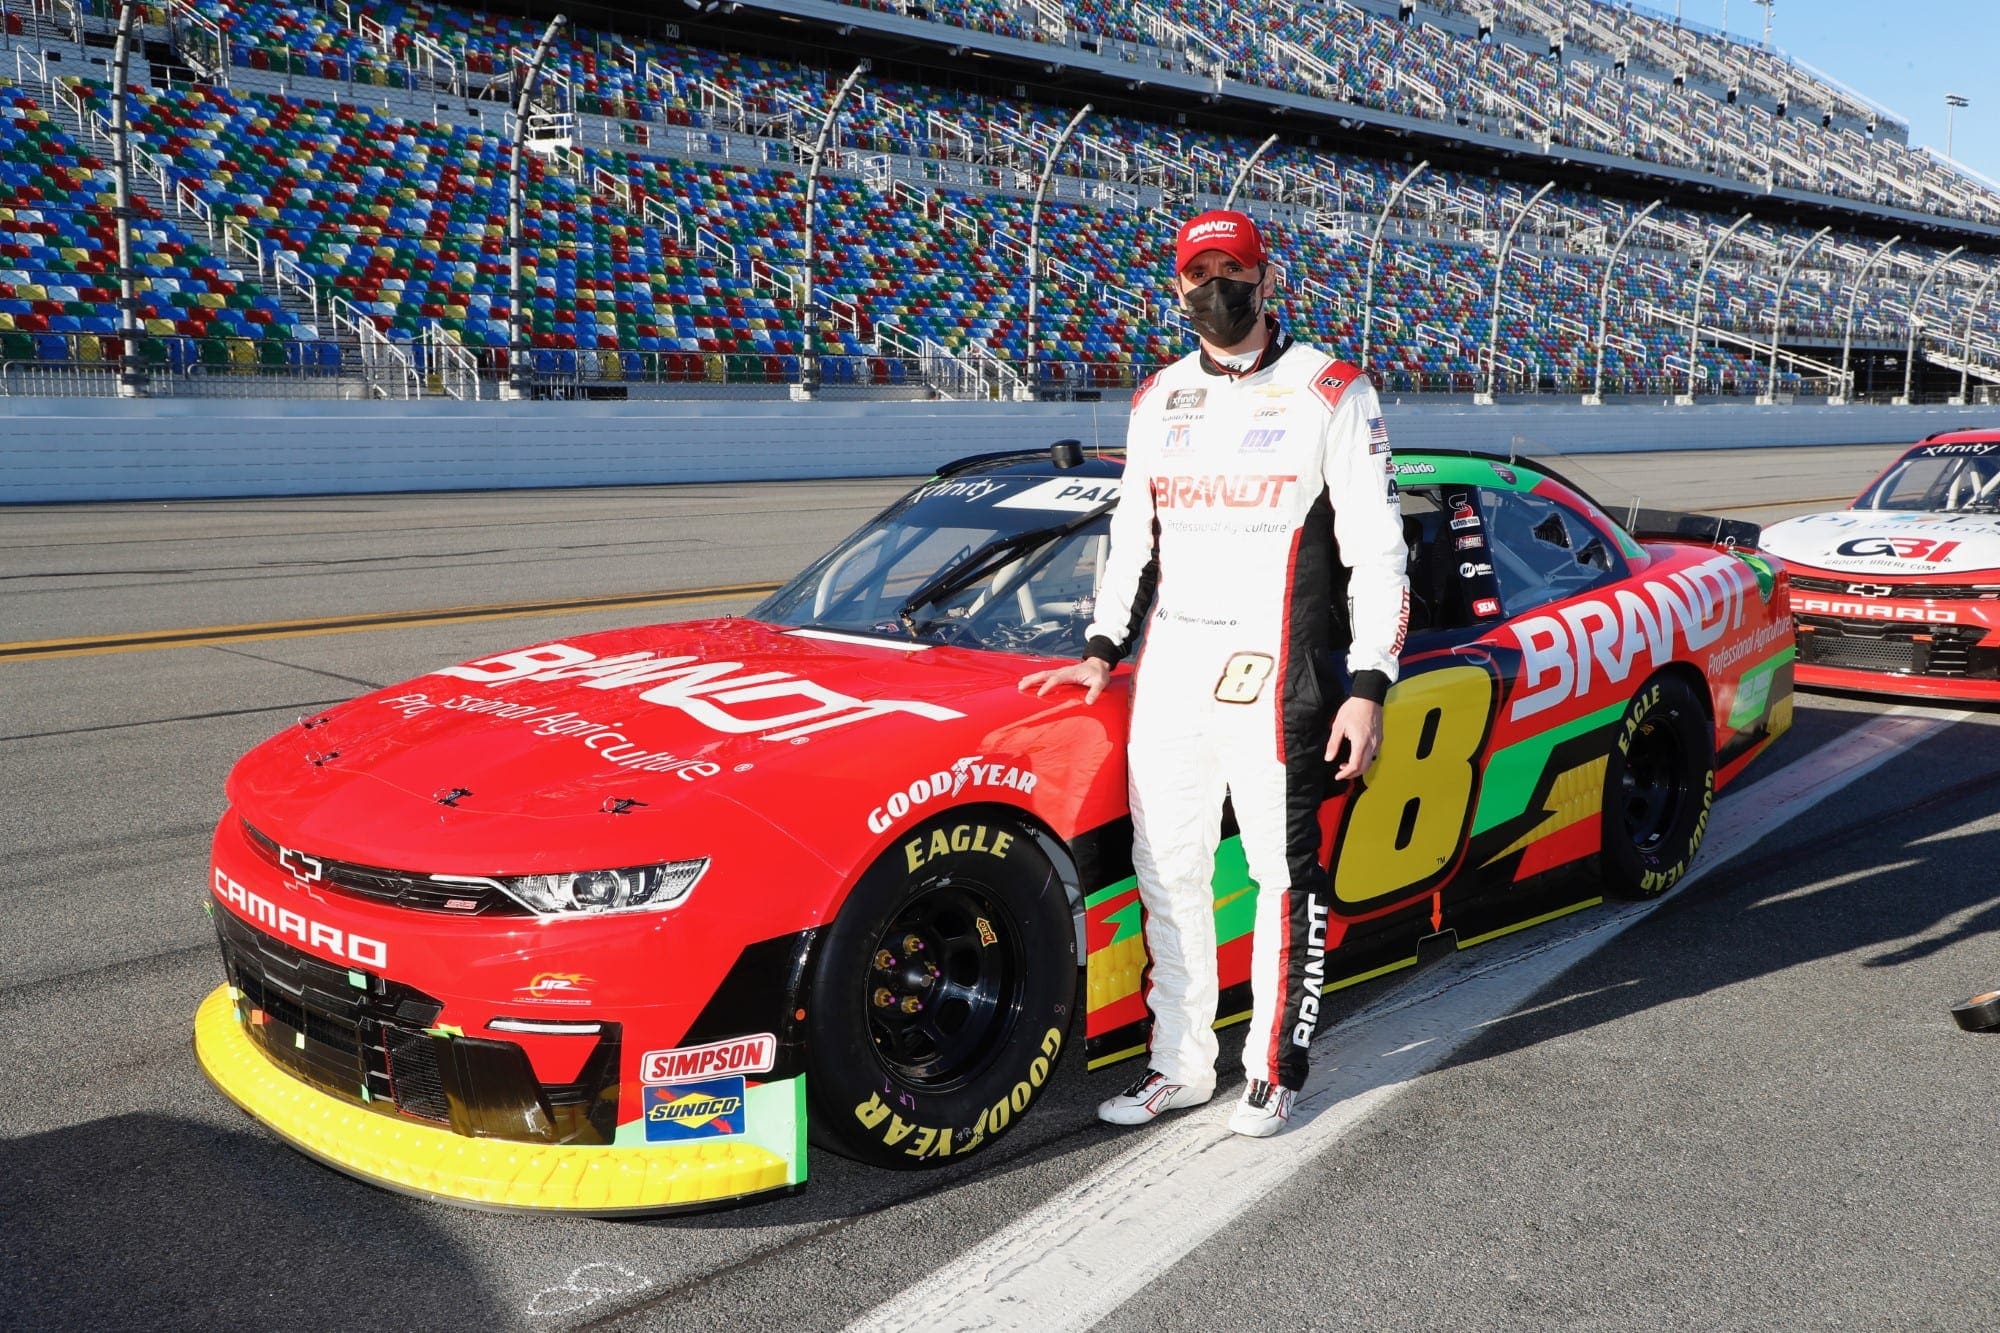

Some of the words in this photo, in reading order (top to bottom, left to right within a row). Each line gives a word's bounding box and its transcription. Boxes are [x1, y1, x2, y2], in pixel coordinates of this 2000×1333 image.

[666, 24, 680, 39] 120
[1186, 221, 1237, 241] BRANDT
[1921, 443, 1999, 457] xfinity
[1392, 462, 1436, 475] Paludo
[908, 479, 1007, 503] xfinity
[1156, 475, 1298, 508] BRANDT
[1837, 537, 1962, 563] GBI
[1477, 601, 1497, 613] SEM
[1510, 554, 1746, 723] BRANDT
[1707, 630, 1755, 679] Professional
[1754, 615, 1791, 653] Agriculture
[1214, 651, 1275, 704] 8
[1618, 684, 1660, 756] EAGLE
[523, 712, 721, 781] Agriculture
[1335, 666, 1492, 903] 8
[904, 825, 1014, 874] EAGLE
[215, 867, 387, 969] CAMARO
[978, 920, 994, 944] AERO
[652, 1041, 764, 1078] SIMPSON
[652, 1099, 737, 1120] SUNOCO
